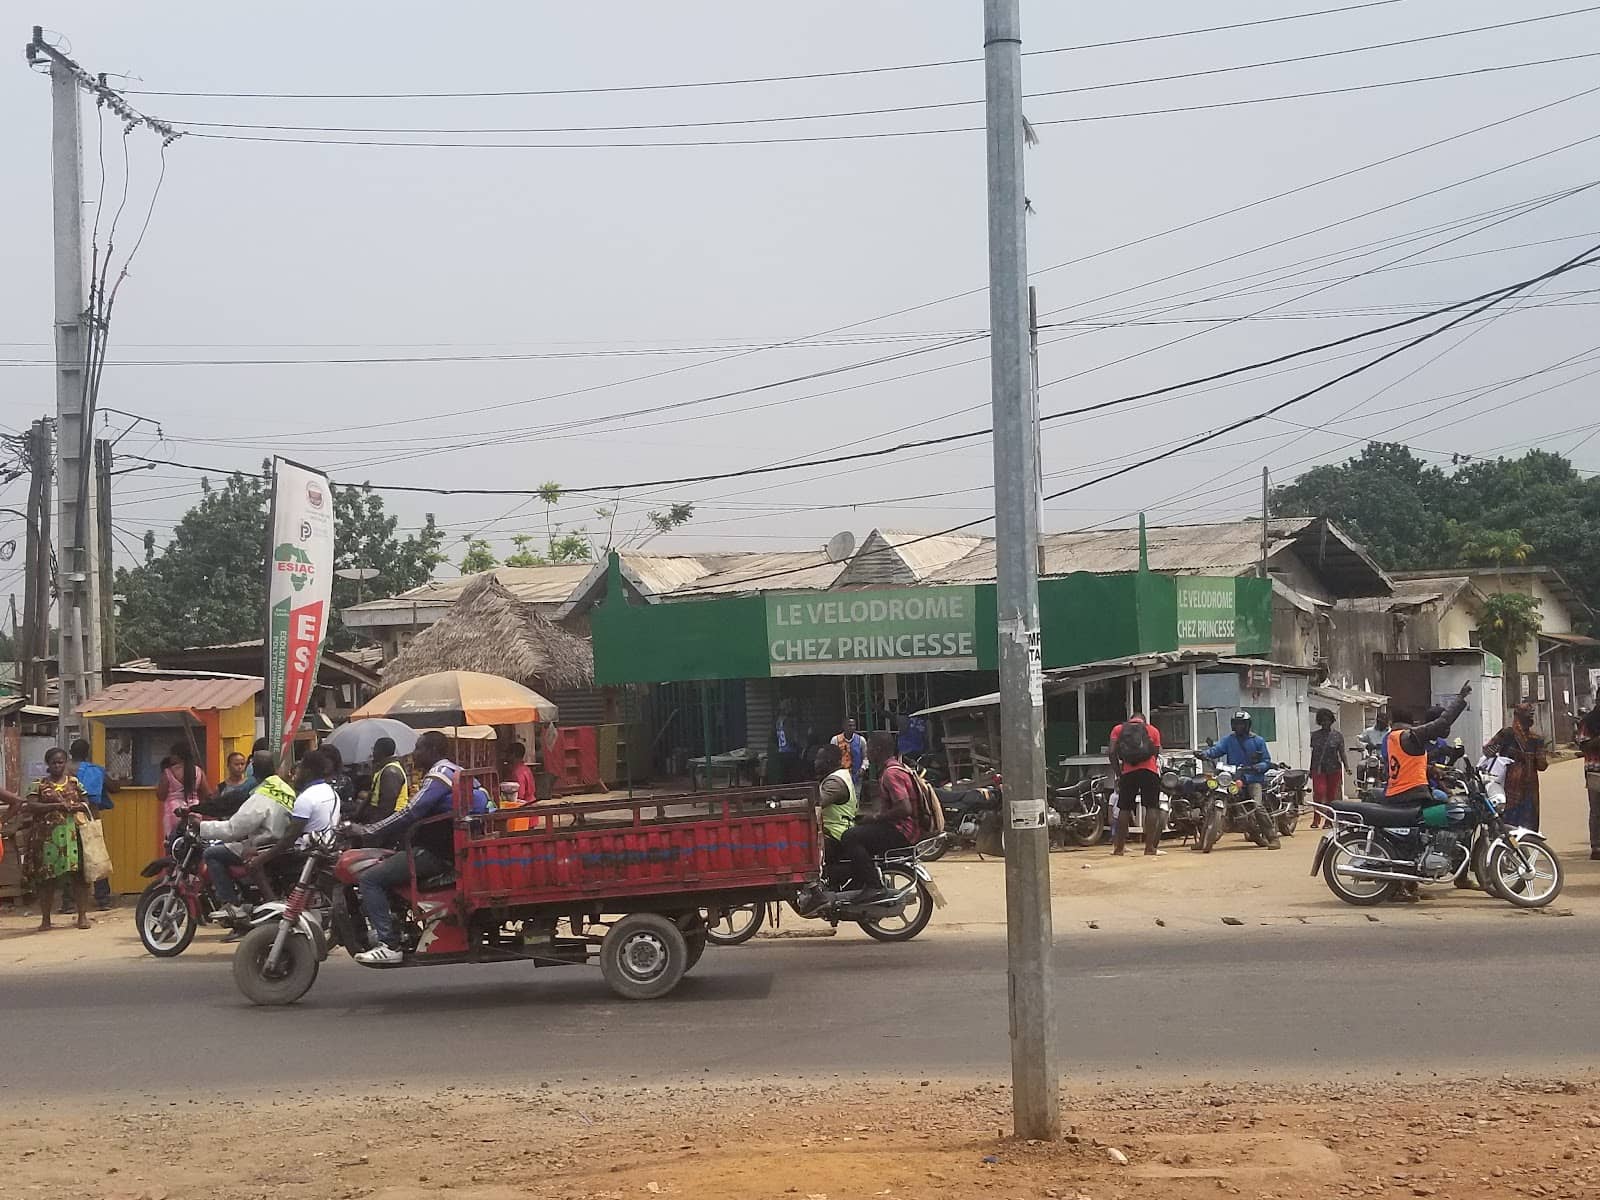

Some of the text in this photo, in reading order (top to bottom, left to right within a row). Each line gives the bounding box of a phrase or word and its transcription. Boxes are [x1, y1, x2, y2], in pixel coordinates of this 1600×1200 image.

[277, 562, 315, 574] ESIAC
[776, 596, 963, 626] LE VELODROME
[1178, 589, 1233, 609] LE VELODROME
[1177, 620, 1235, 638] CHEZ PRINCESSE
[279, 630, 288, 657] ECOLE
[770, 632, 973, 661] CHEZ PRINCESSE
[276, 657, 286, 702] NATIONALE
